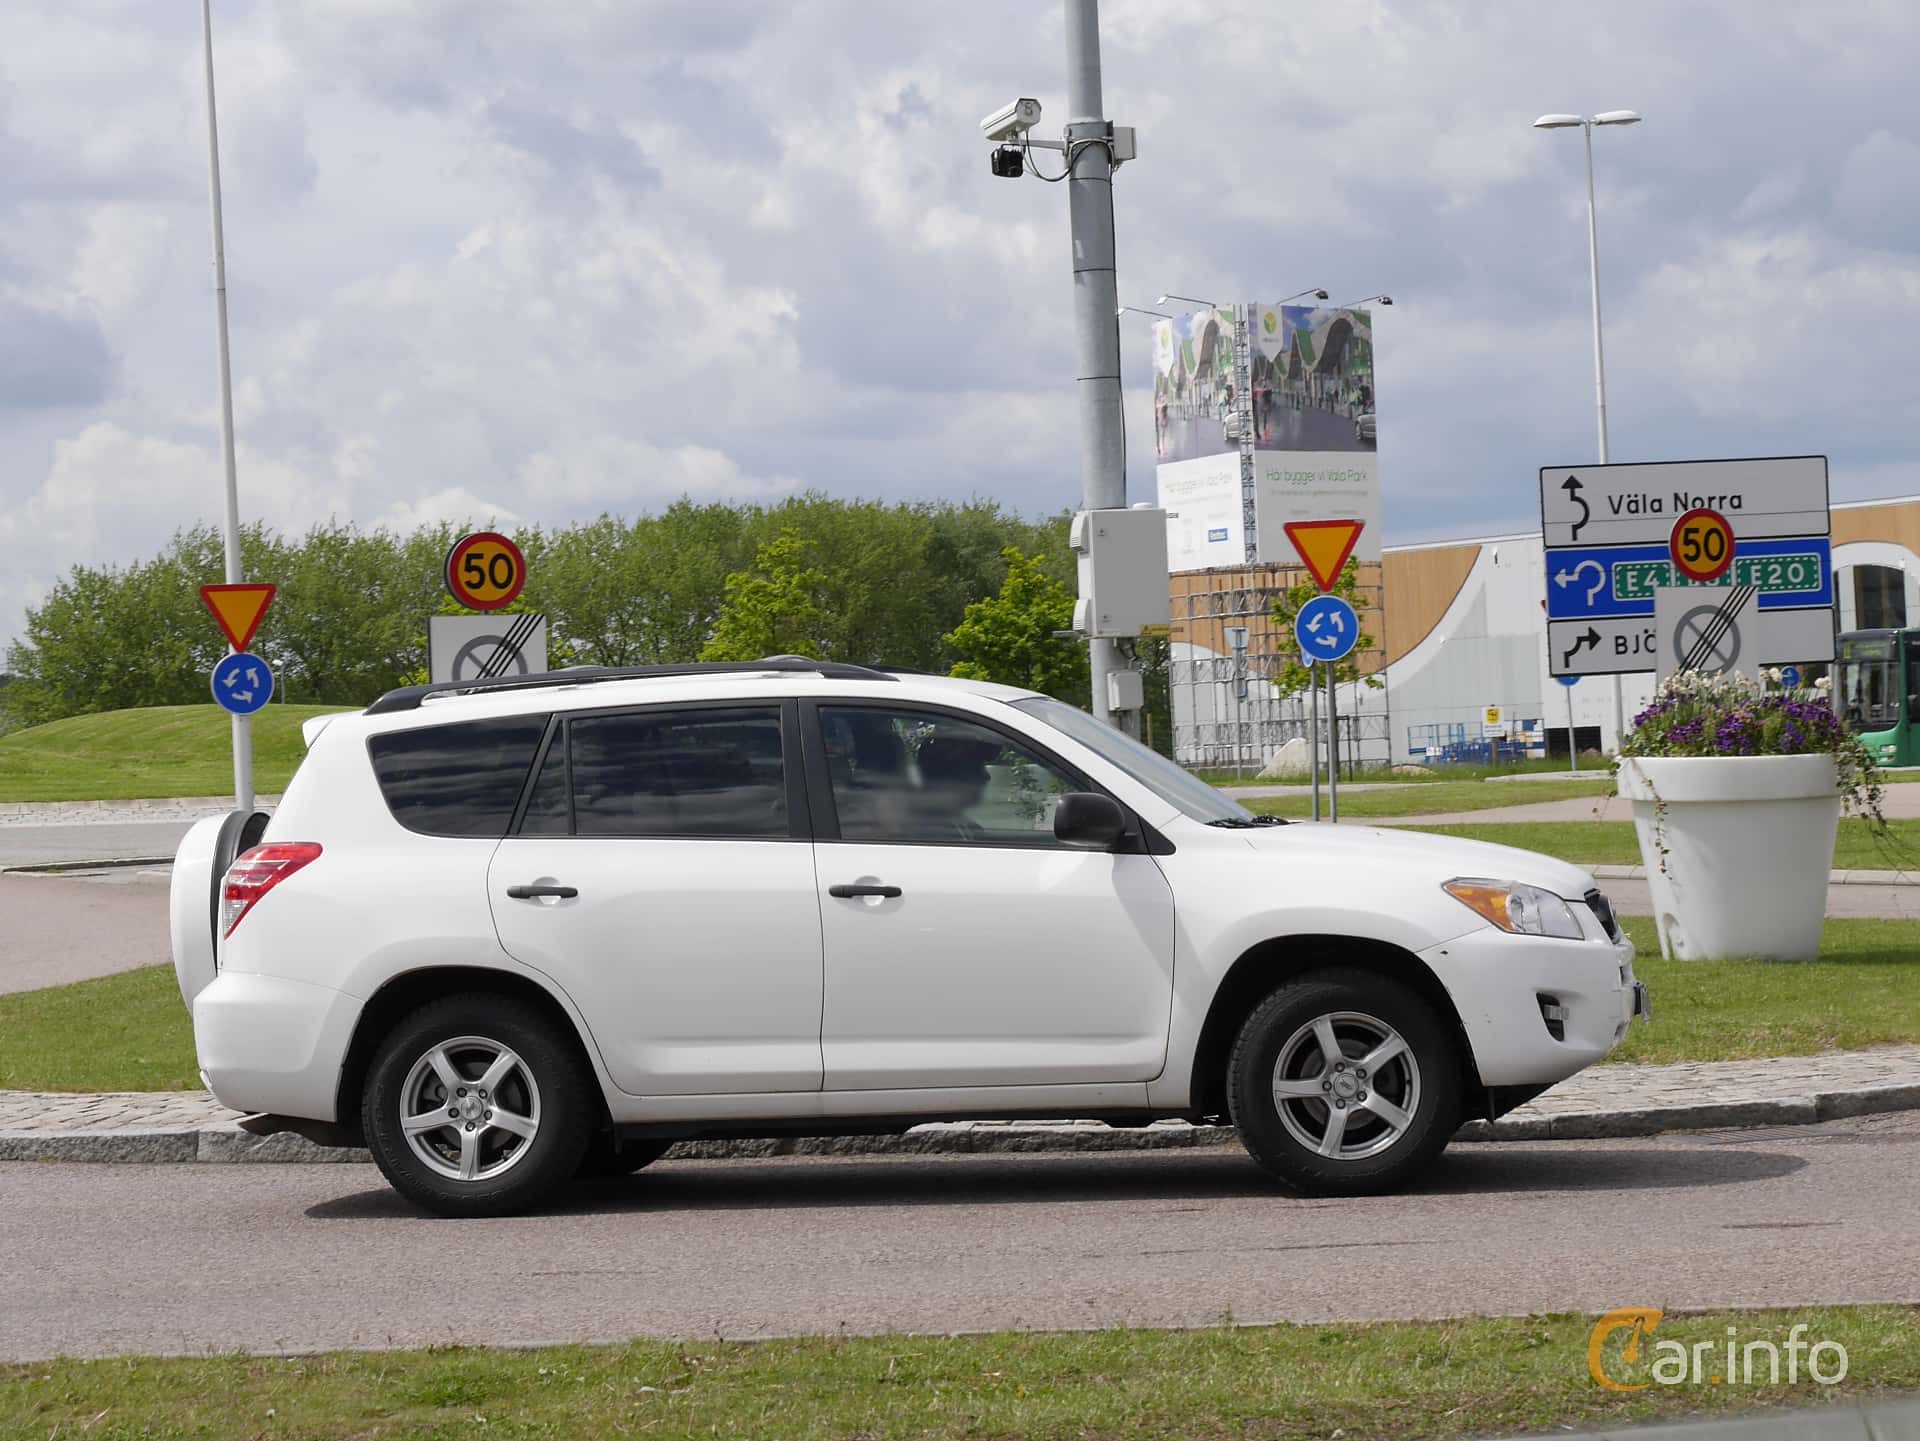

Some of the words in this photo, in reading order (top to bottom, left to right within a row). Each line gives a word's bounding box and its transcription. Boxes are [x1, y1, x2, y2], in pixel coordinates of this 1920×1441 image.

[1607, 493, 1663, 515] Väla
[1673, 491, 1743, 512] Norra
[1683, 527, 1726, 562] 50
[464, 553, 514, 590] 50
[1751, 563, 1805, 586] E20
